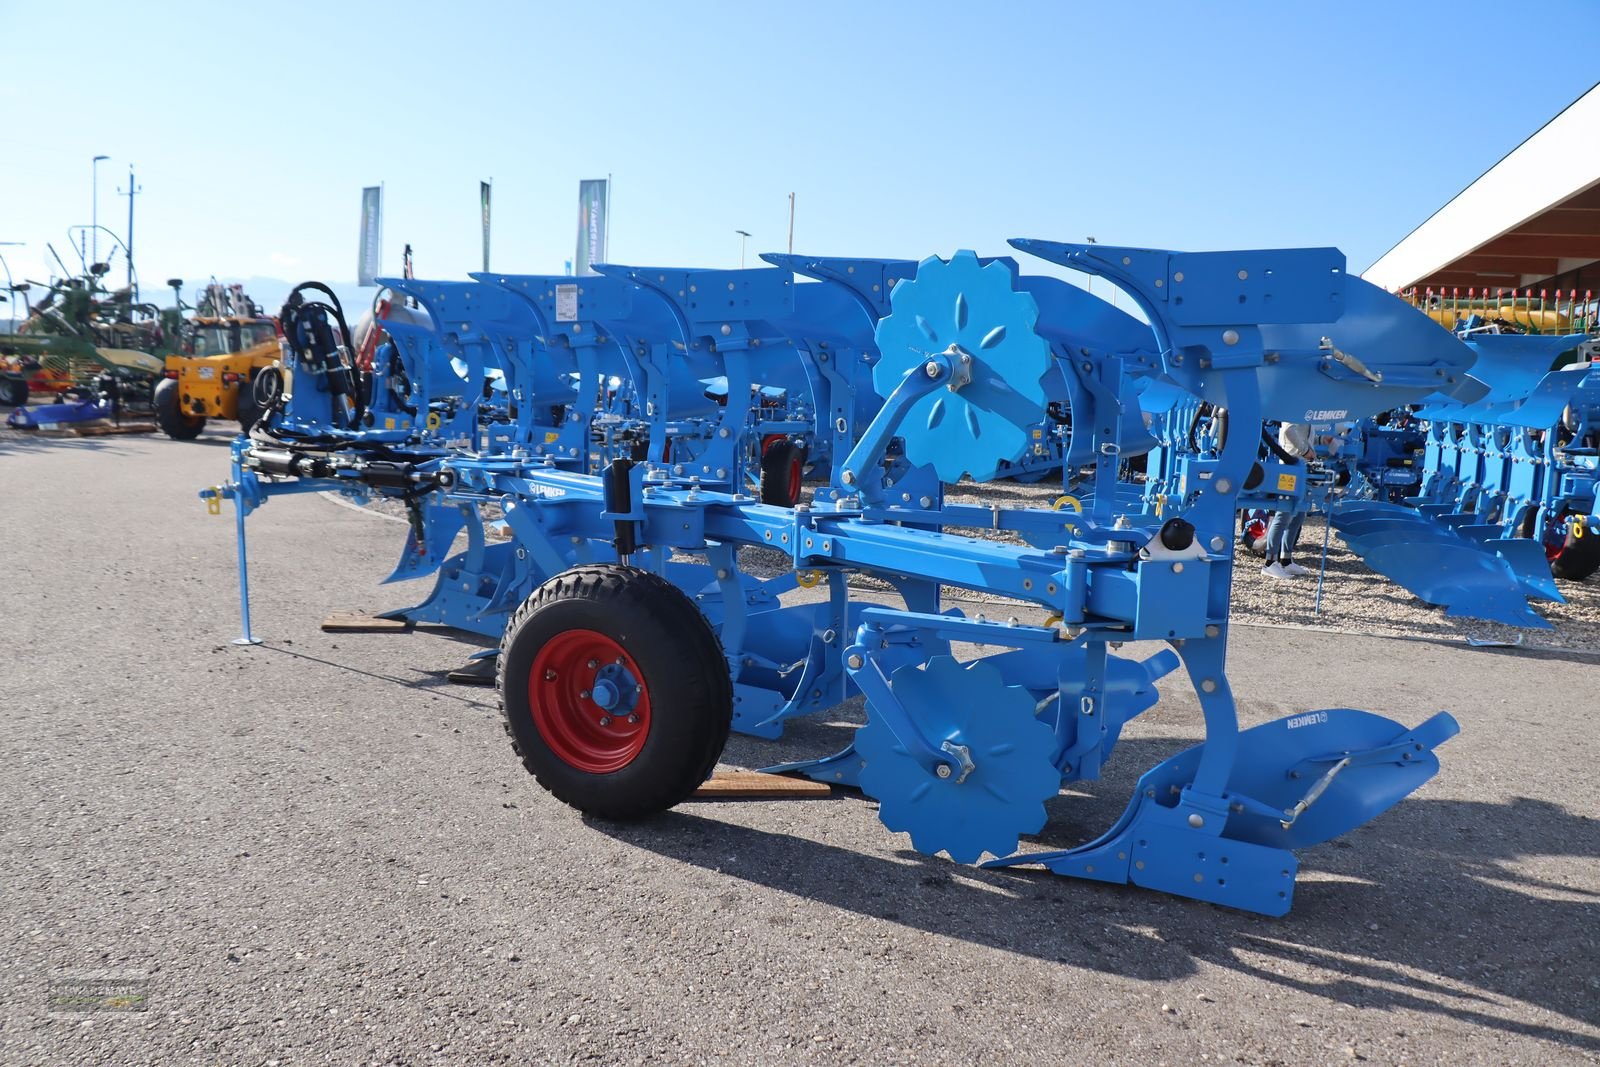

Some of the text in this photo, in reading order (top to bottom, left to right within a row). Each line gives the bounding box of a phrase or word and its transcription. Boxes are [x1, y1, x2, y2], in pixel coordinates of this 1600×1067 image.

[1312, 409, 1348, 420] LEMKEN
[536, 484, 566, 497] LEMKEN
[1287, 713, 1320, 729] LEMKEN
